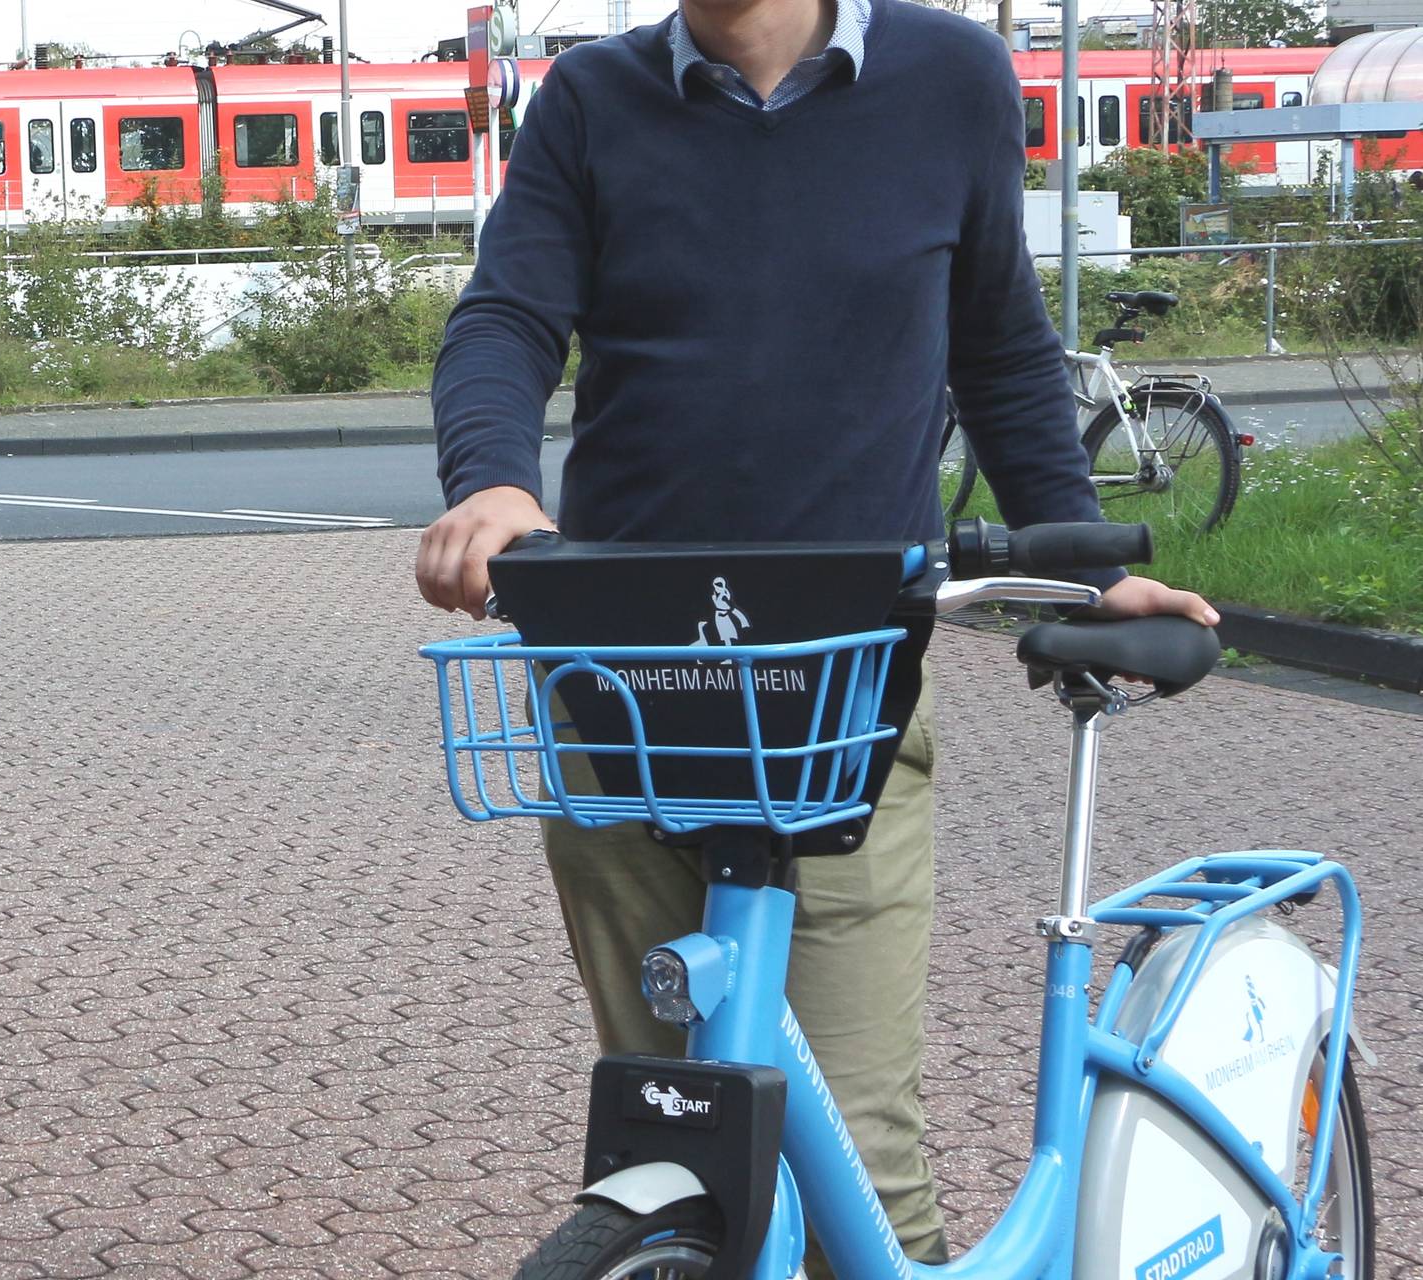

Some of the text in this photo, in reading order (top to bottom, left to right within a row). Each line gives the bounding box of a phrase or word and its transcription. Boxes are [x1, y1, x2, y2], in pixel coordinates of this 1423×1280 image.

[490, 11, 503, 53] S
[673, 1098, 712, 1114] START
[1144, 1230, 1215, 1280] STADTRAD
